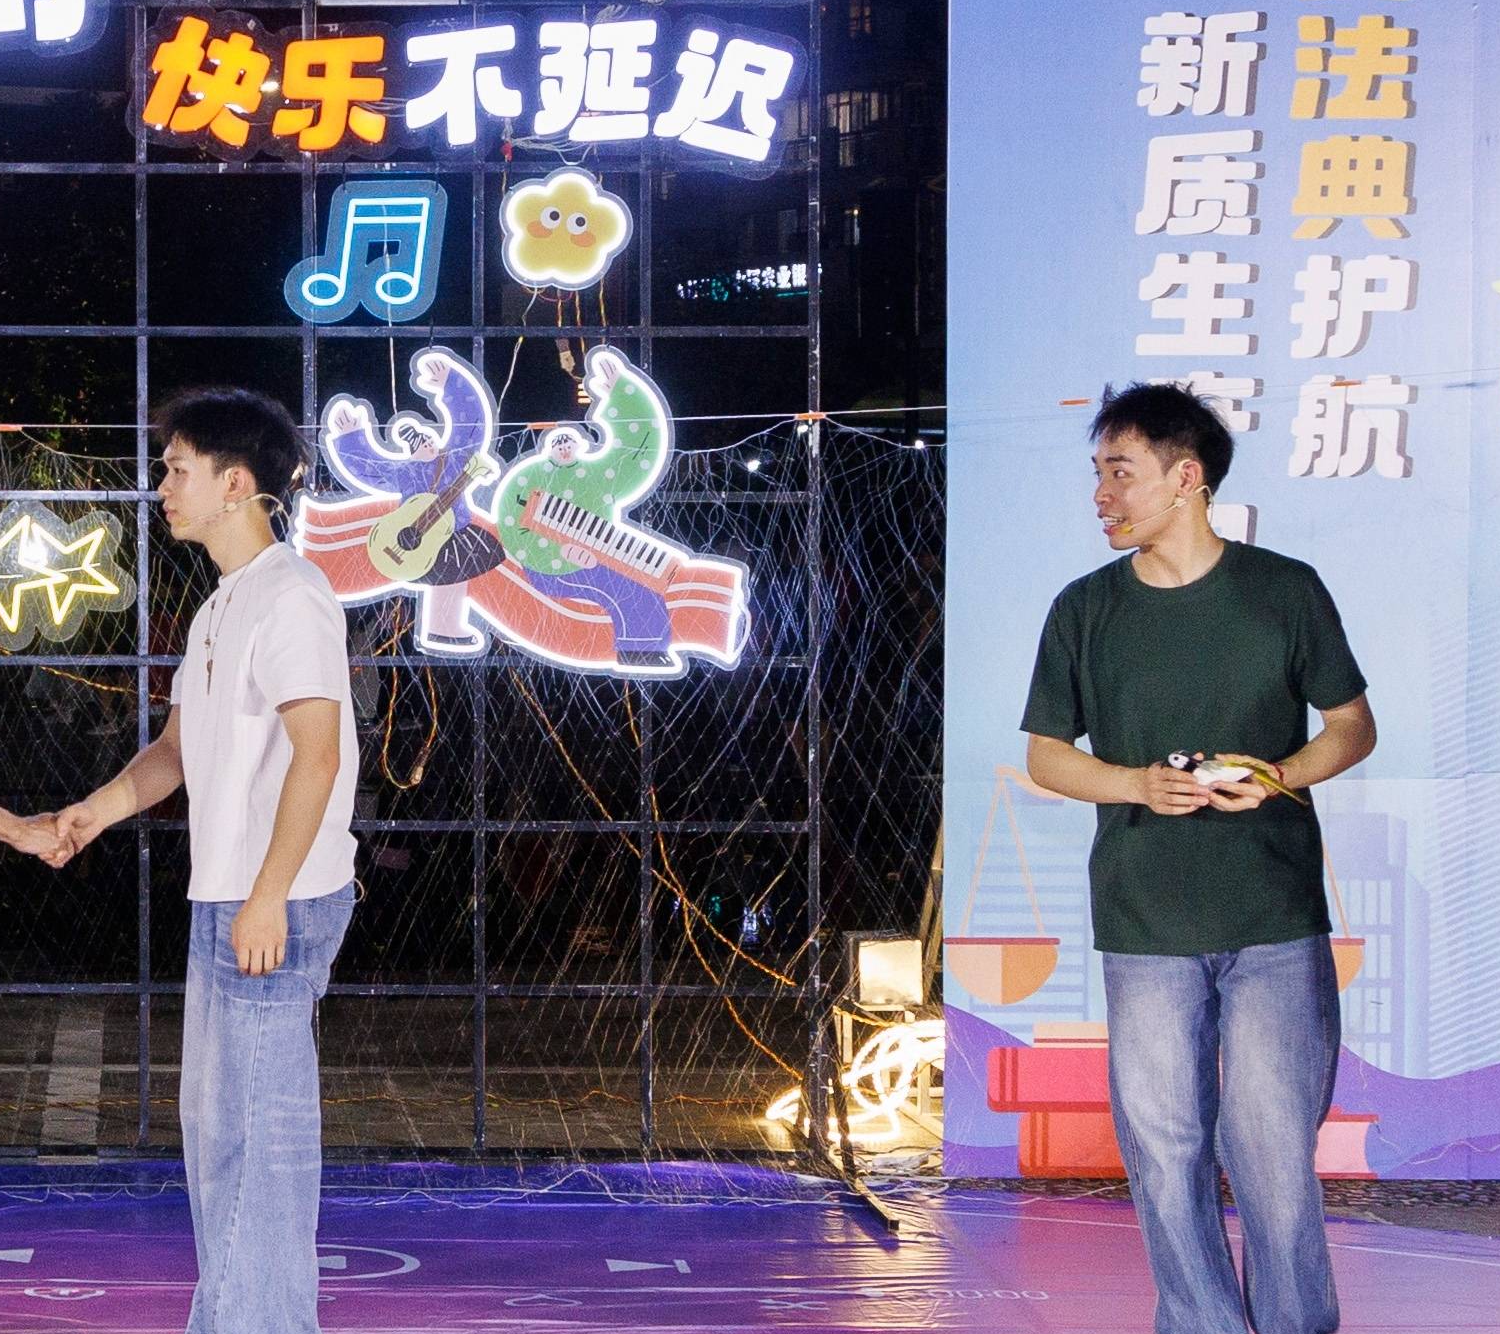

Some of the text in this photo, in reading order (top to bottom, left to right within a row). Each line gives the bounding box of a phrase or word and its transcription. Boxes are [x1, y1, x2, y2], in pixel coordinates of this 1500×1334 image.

[142, 14, 795, 163] 快乐不延迟
[1134, 11, 1267, 545] 新质生
